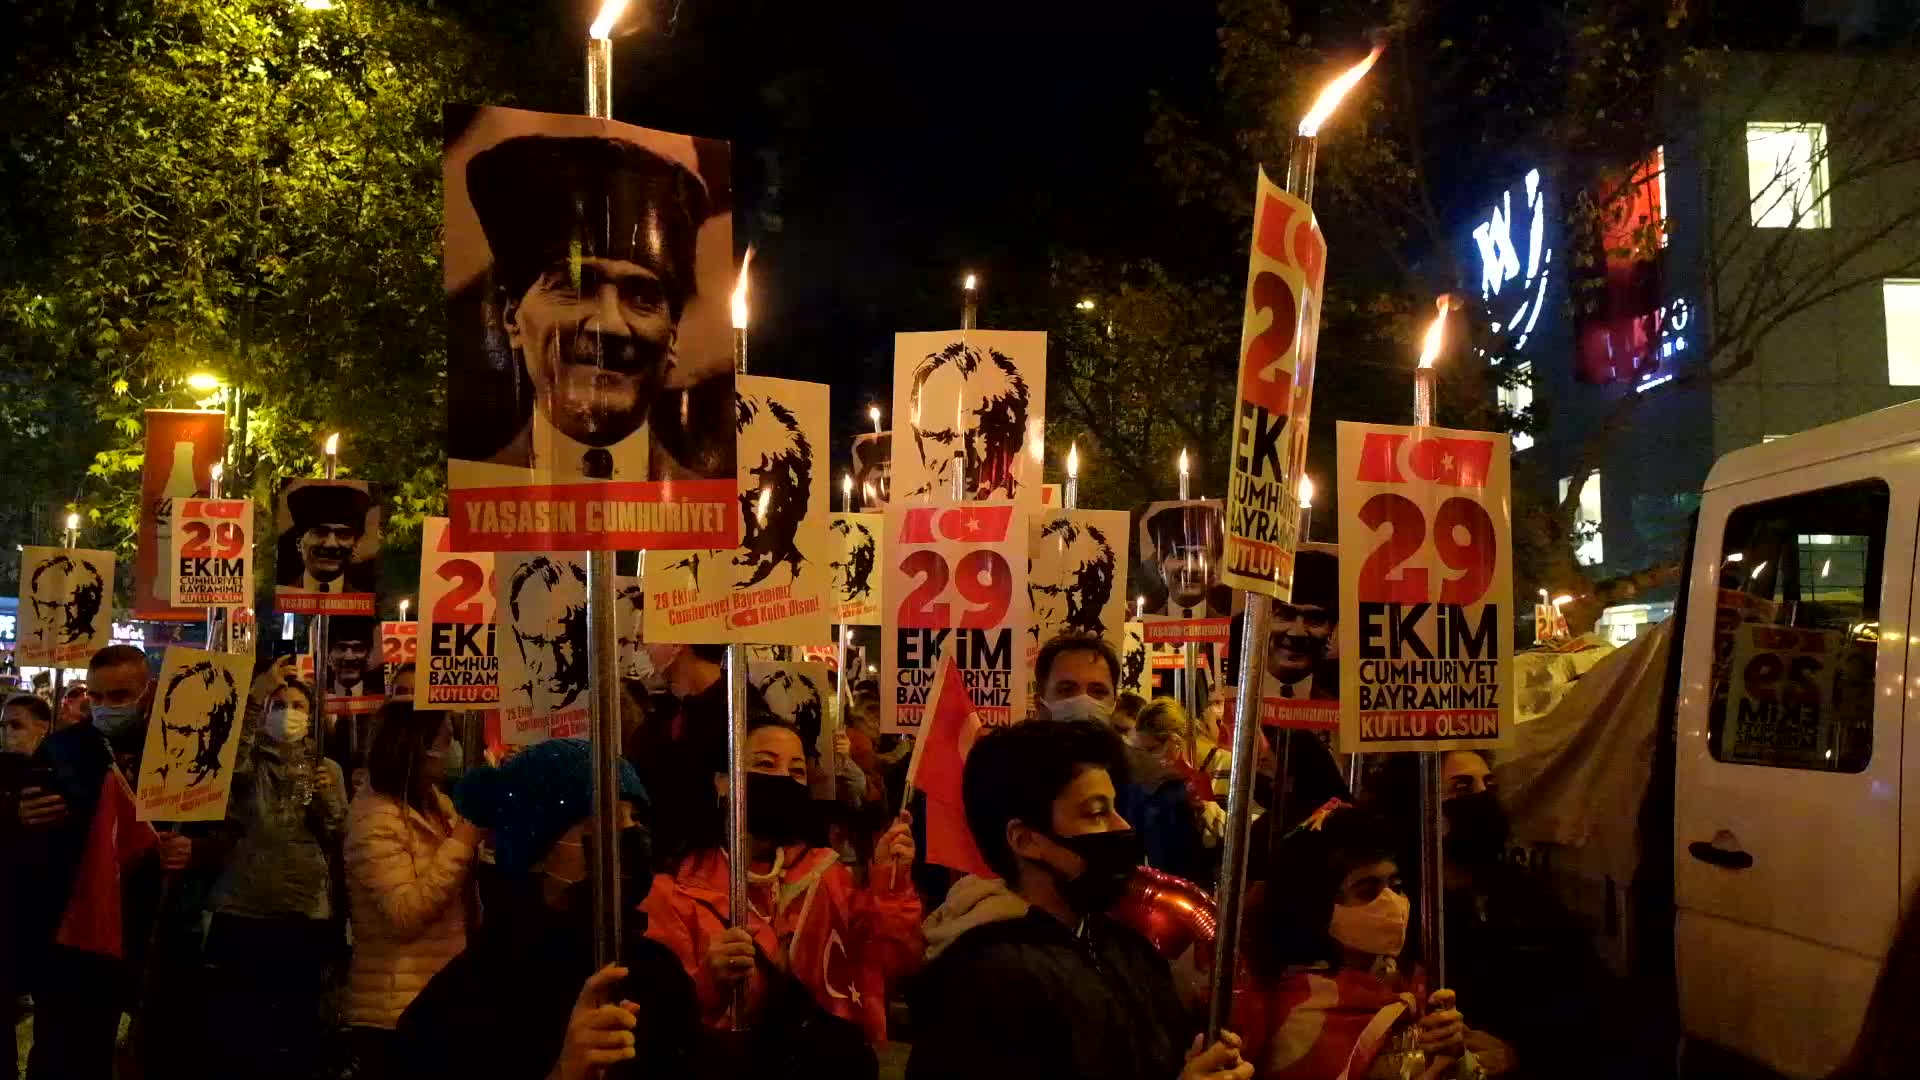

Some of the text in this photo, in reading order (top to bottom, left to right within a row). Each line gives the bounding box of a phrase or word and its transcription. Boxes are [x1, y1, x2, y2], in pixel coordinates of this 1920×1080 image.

[1244, 271, 1306, 417] 2
[466, 500, 577, 537] YAŞASIN
[181, 521, 244, 559] 29
[1358, 493, 1497, 607] 29
[432, 558, 497, 624] 2
[897, 549, 1013, 630] 29
[430, 623, 497, 656] EKİ
[429, 671, 498, 686] BAYRAM
[430, 656, 498, 671] CUMHUR
[430, 688, 479, 702] KUTLU
[1359, 684, 1499, 710] BAYRAMIMIZ
[1360, 714, 1498, 738] KUTLU OLSUN
